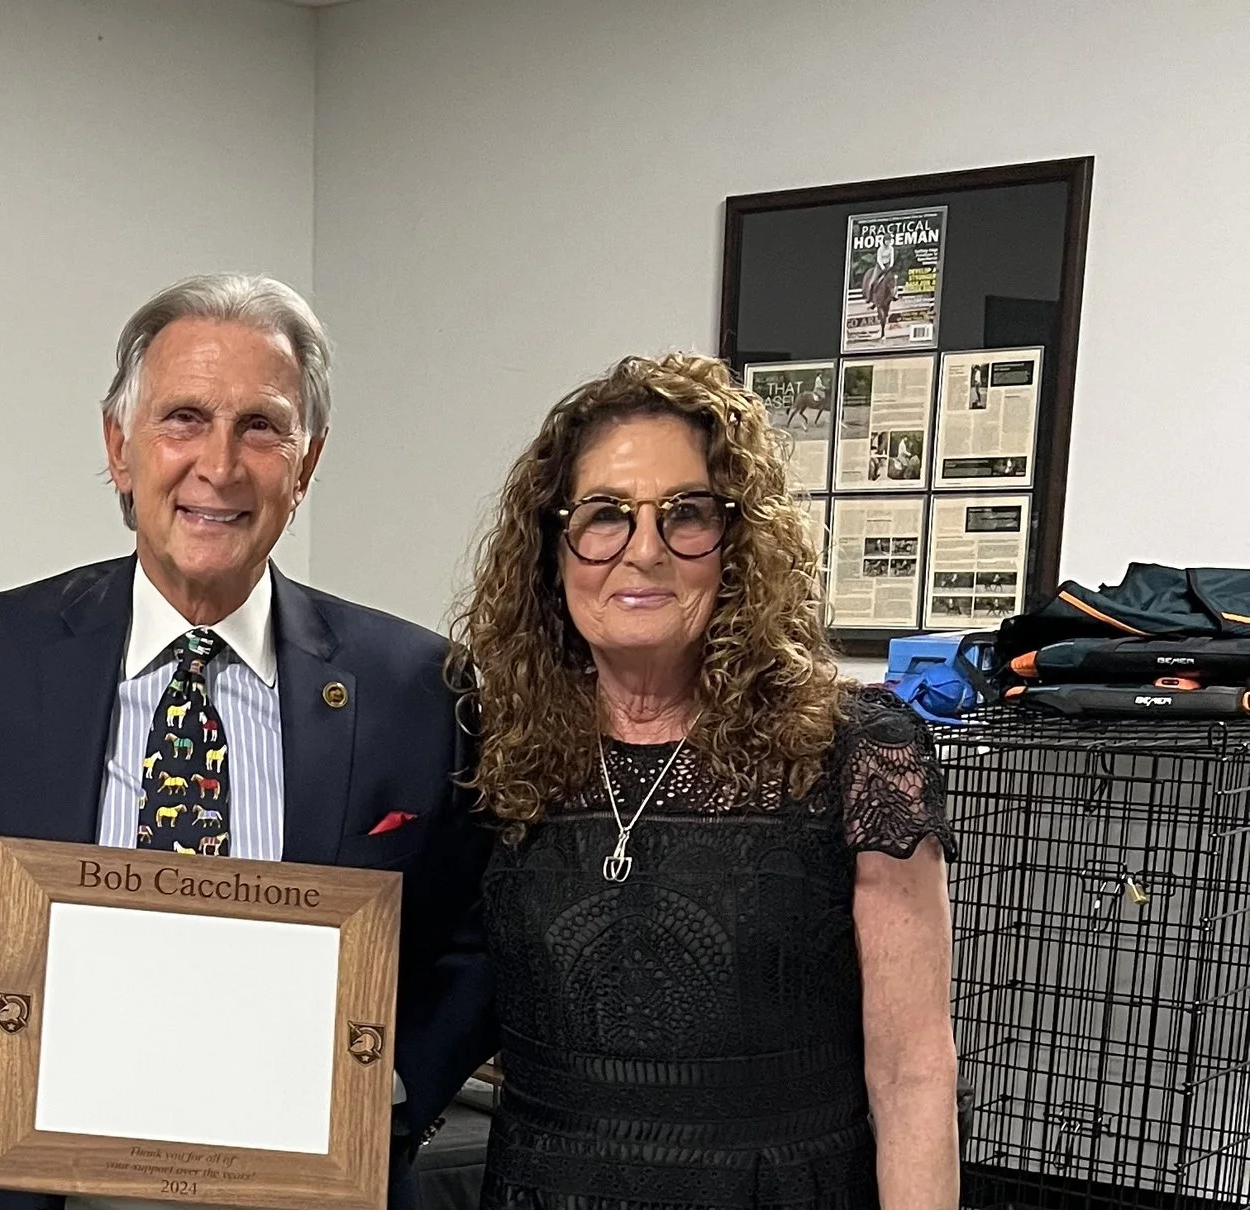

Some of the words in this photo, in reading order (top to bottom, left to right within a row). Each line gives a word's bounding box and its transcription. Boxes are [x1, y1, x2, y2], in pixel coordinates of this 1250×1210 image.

[861, 220, 931, 236] PRACTICAL
[766, 381, 803, 396] THAT
[78, 860, 142, 893] Bob
[153, 867, 321, 907] Cacchione
[130, 1146, 161, 1158] Thank
[131, 1164, 174, 1175] support
[160, 1180, 199, 1195] 2024
